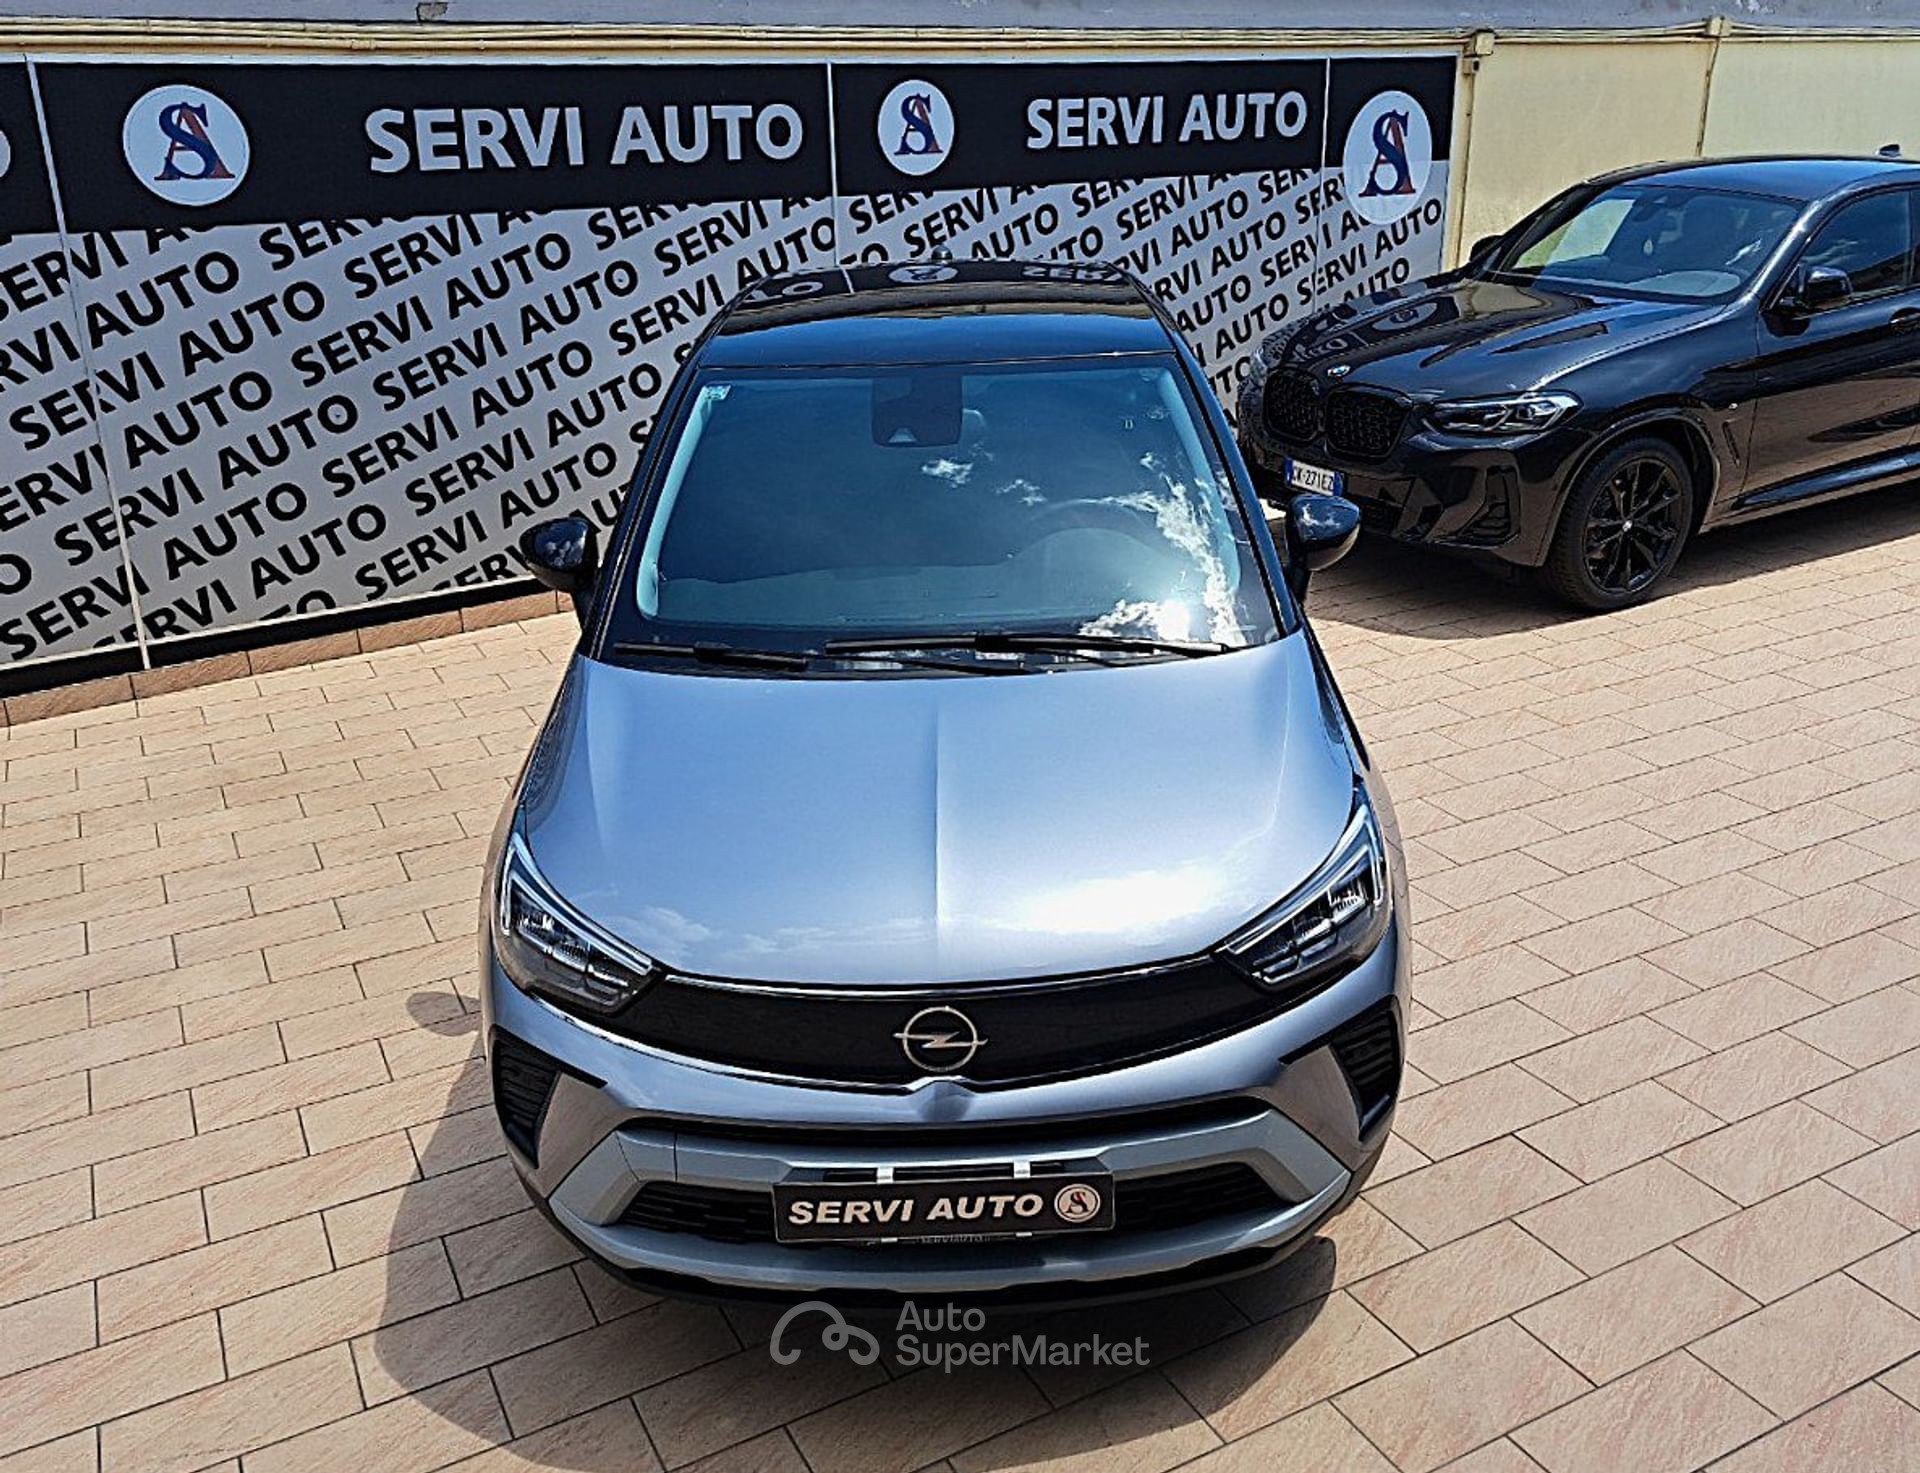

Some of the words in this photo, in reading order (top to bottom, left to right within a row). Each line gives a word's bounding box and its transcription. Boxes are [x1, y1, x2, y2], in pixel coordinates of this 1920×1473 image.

[365, 107, 585, 173] SERVI
[611, 103, 803, 165] AUTO
[1027, 97, 1164, 149] SERVI
[1180, 91, 1307, 143] AUTO
[904, 187, 999, 258] SERVI
[971, 203, 1058, 260] AUTO
[1116, 175, 1198, 240] SERVI
[1171, 190, 1248, 256] AUTO
[1211, 211, 1286, 276] AUTO
[0, 230, 128, 321] ERVI
[0, 321, 80, 392] RVI
[86, 252, 239, 348] AUTO
[180, 281, 325, 377] AUTO
[344, 213, 483, 299] SERVI
[1176, 274, 1250, 334] AUTO
[1260, 222, 1332, 288] SERVI
[1215, 294, 1288, 359] AUTO
[1296, 243, 1367, 306] SERVI
[1375, 198, 1442, 260] AUTO
[0, 443, 109, 531] ERVI
[124, 371, 272, 468] AUTO
[291, 296, 433, 387] SERVI
[447, 233, 571, 319] AUTO
[54, 468, 205, 566] SERVI
[218, 395, 358, 490] AUTO
[373, 322, 508, 411] SERVI
[520, 260, 639, 345] AUTO
[654, 200, 768, 277] SERVI
[164, 482, 307, 581] AUTO
[322, 406, 459, 497] SERVI
[472, 341, 593, 428] AUTO
[609, 274, 726, 356] SERVI
[737, 217, 836, 290] AUTO
[251, 504, 386, 599] AUTO
[406, 427, 535, 516] SERVI
[547, 363, 661, 448] AUTO
[355, 510, 488, 600] SERVI
[500, 442, 616, 528] AUTO
[788, 1200, 913, 1225] SERVI
[926, 1194, 1043, 1220] AUTO
